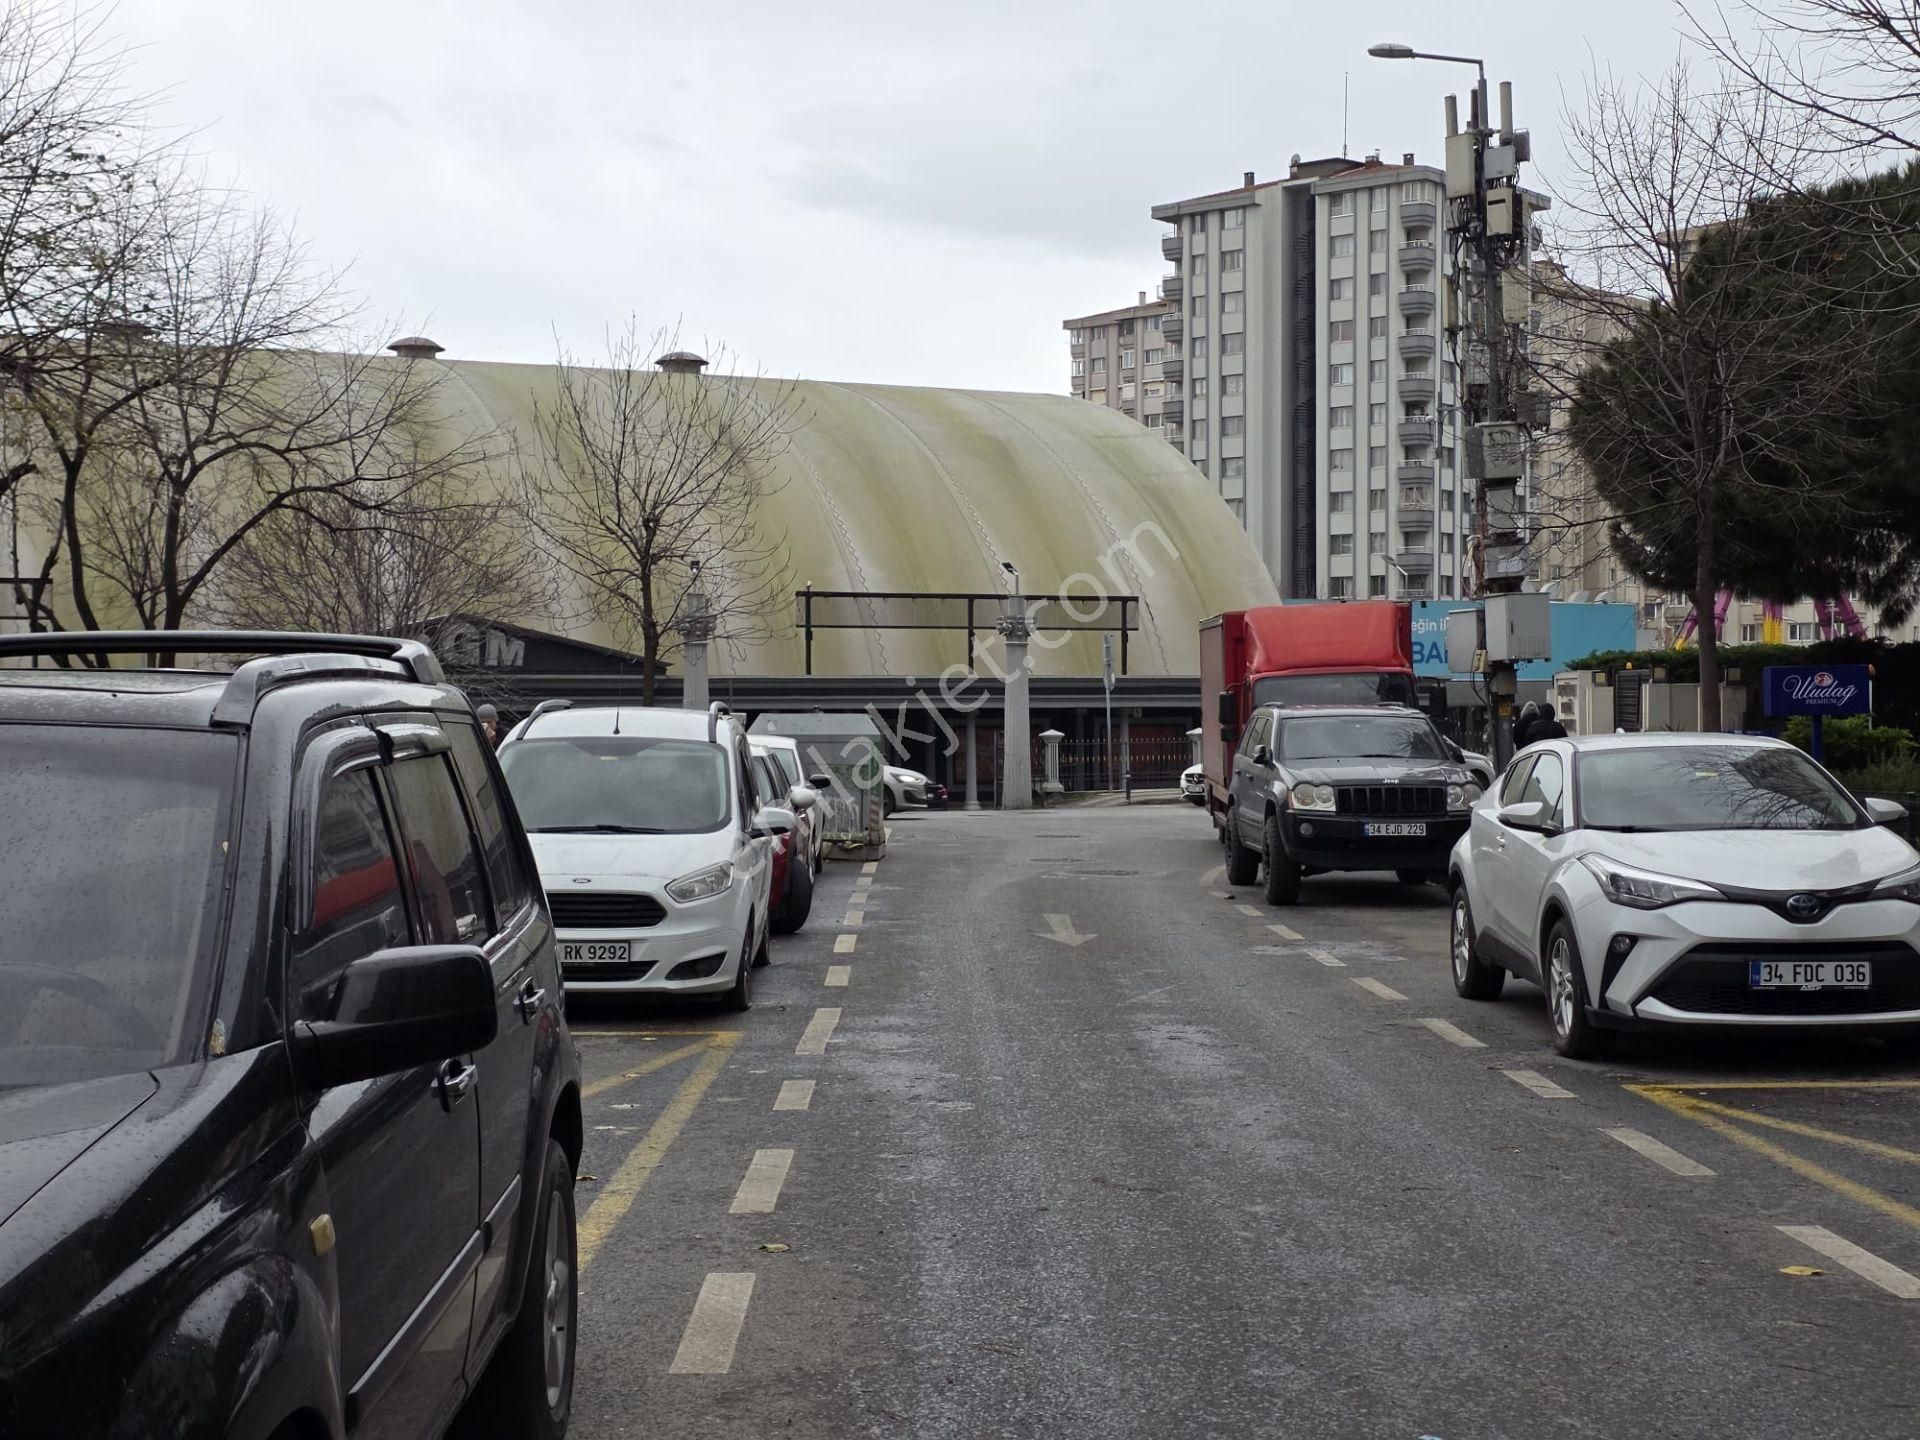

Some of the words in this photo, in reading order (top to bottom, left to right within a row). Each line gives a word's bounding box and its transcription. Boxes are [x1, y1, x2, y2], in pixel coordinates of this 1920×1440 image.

[1411, 618, 1437, 634] eğin
[1782, 674, 1858, 706] Uludağ
[1370, 824, 1381, 835] 34
[1385, 824, 1403, 835] EJD
[1407, 824, 1425, 835] 229
[564, 945, 583, 960] RK
[588, 945, 627, 960] 9292
[1763, 964, 1783, 983] 34
[1793, 963, 1825, 983] FDC
[1834, 963, 1866, 983] 036
